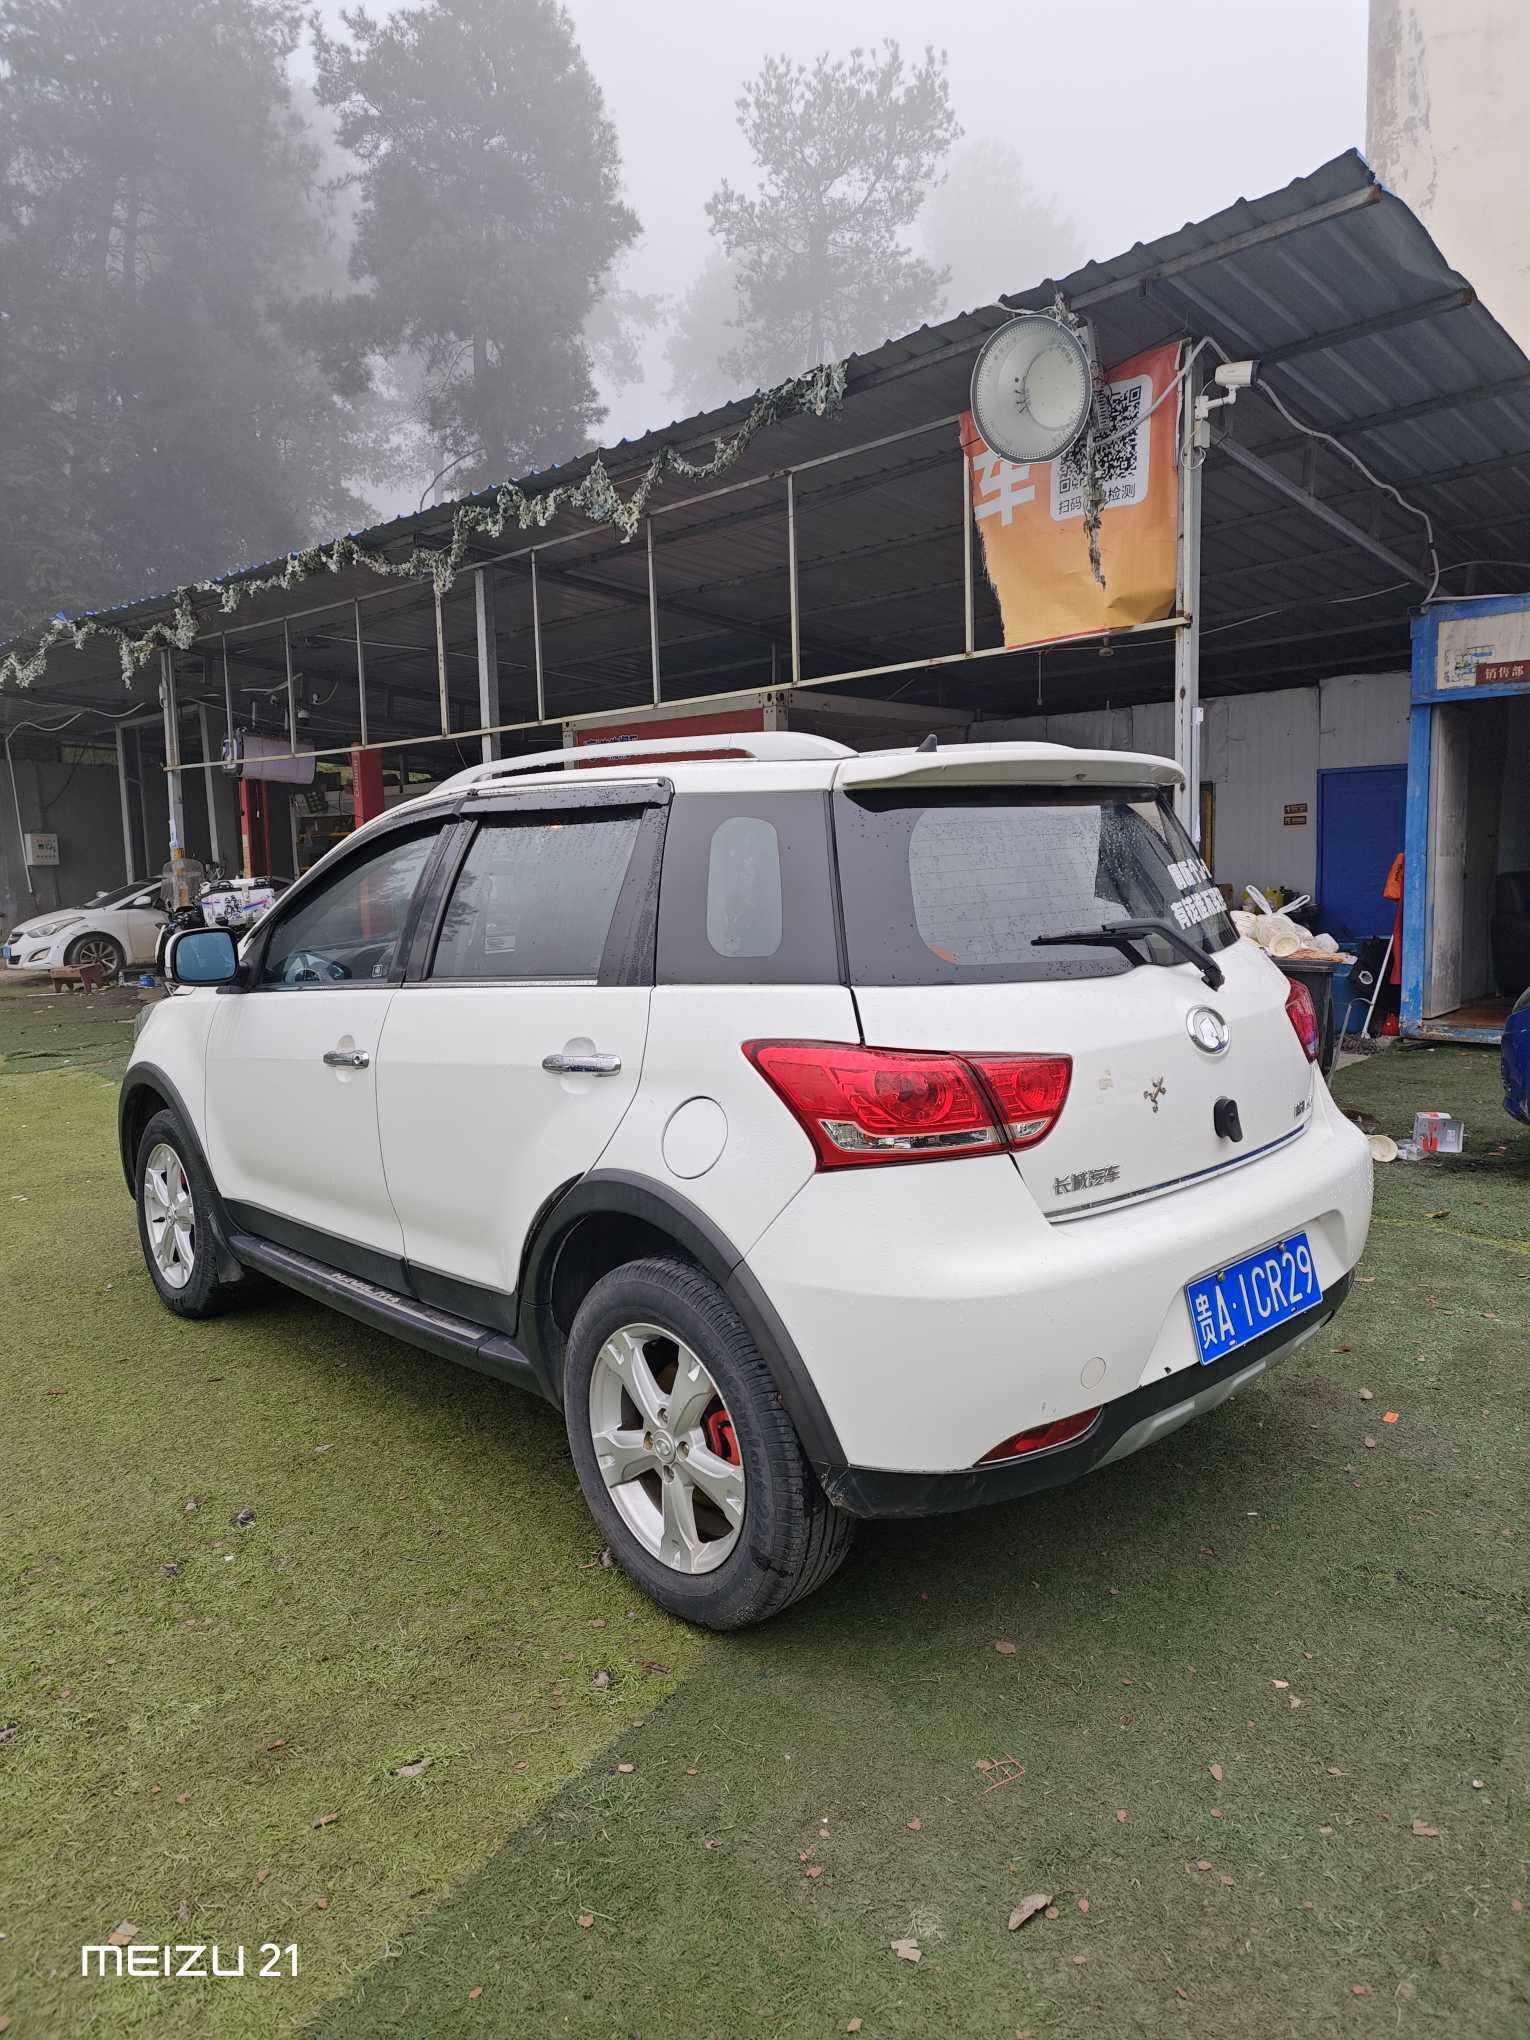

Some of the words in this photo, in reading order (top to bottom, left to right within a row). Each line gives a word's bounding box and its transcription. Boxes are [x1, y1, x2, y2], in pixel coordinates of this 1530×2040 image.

[1059, 483, 1136, 515] 扫码检测
[1054, 1164, 1121, 1195] 长城汽车
